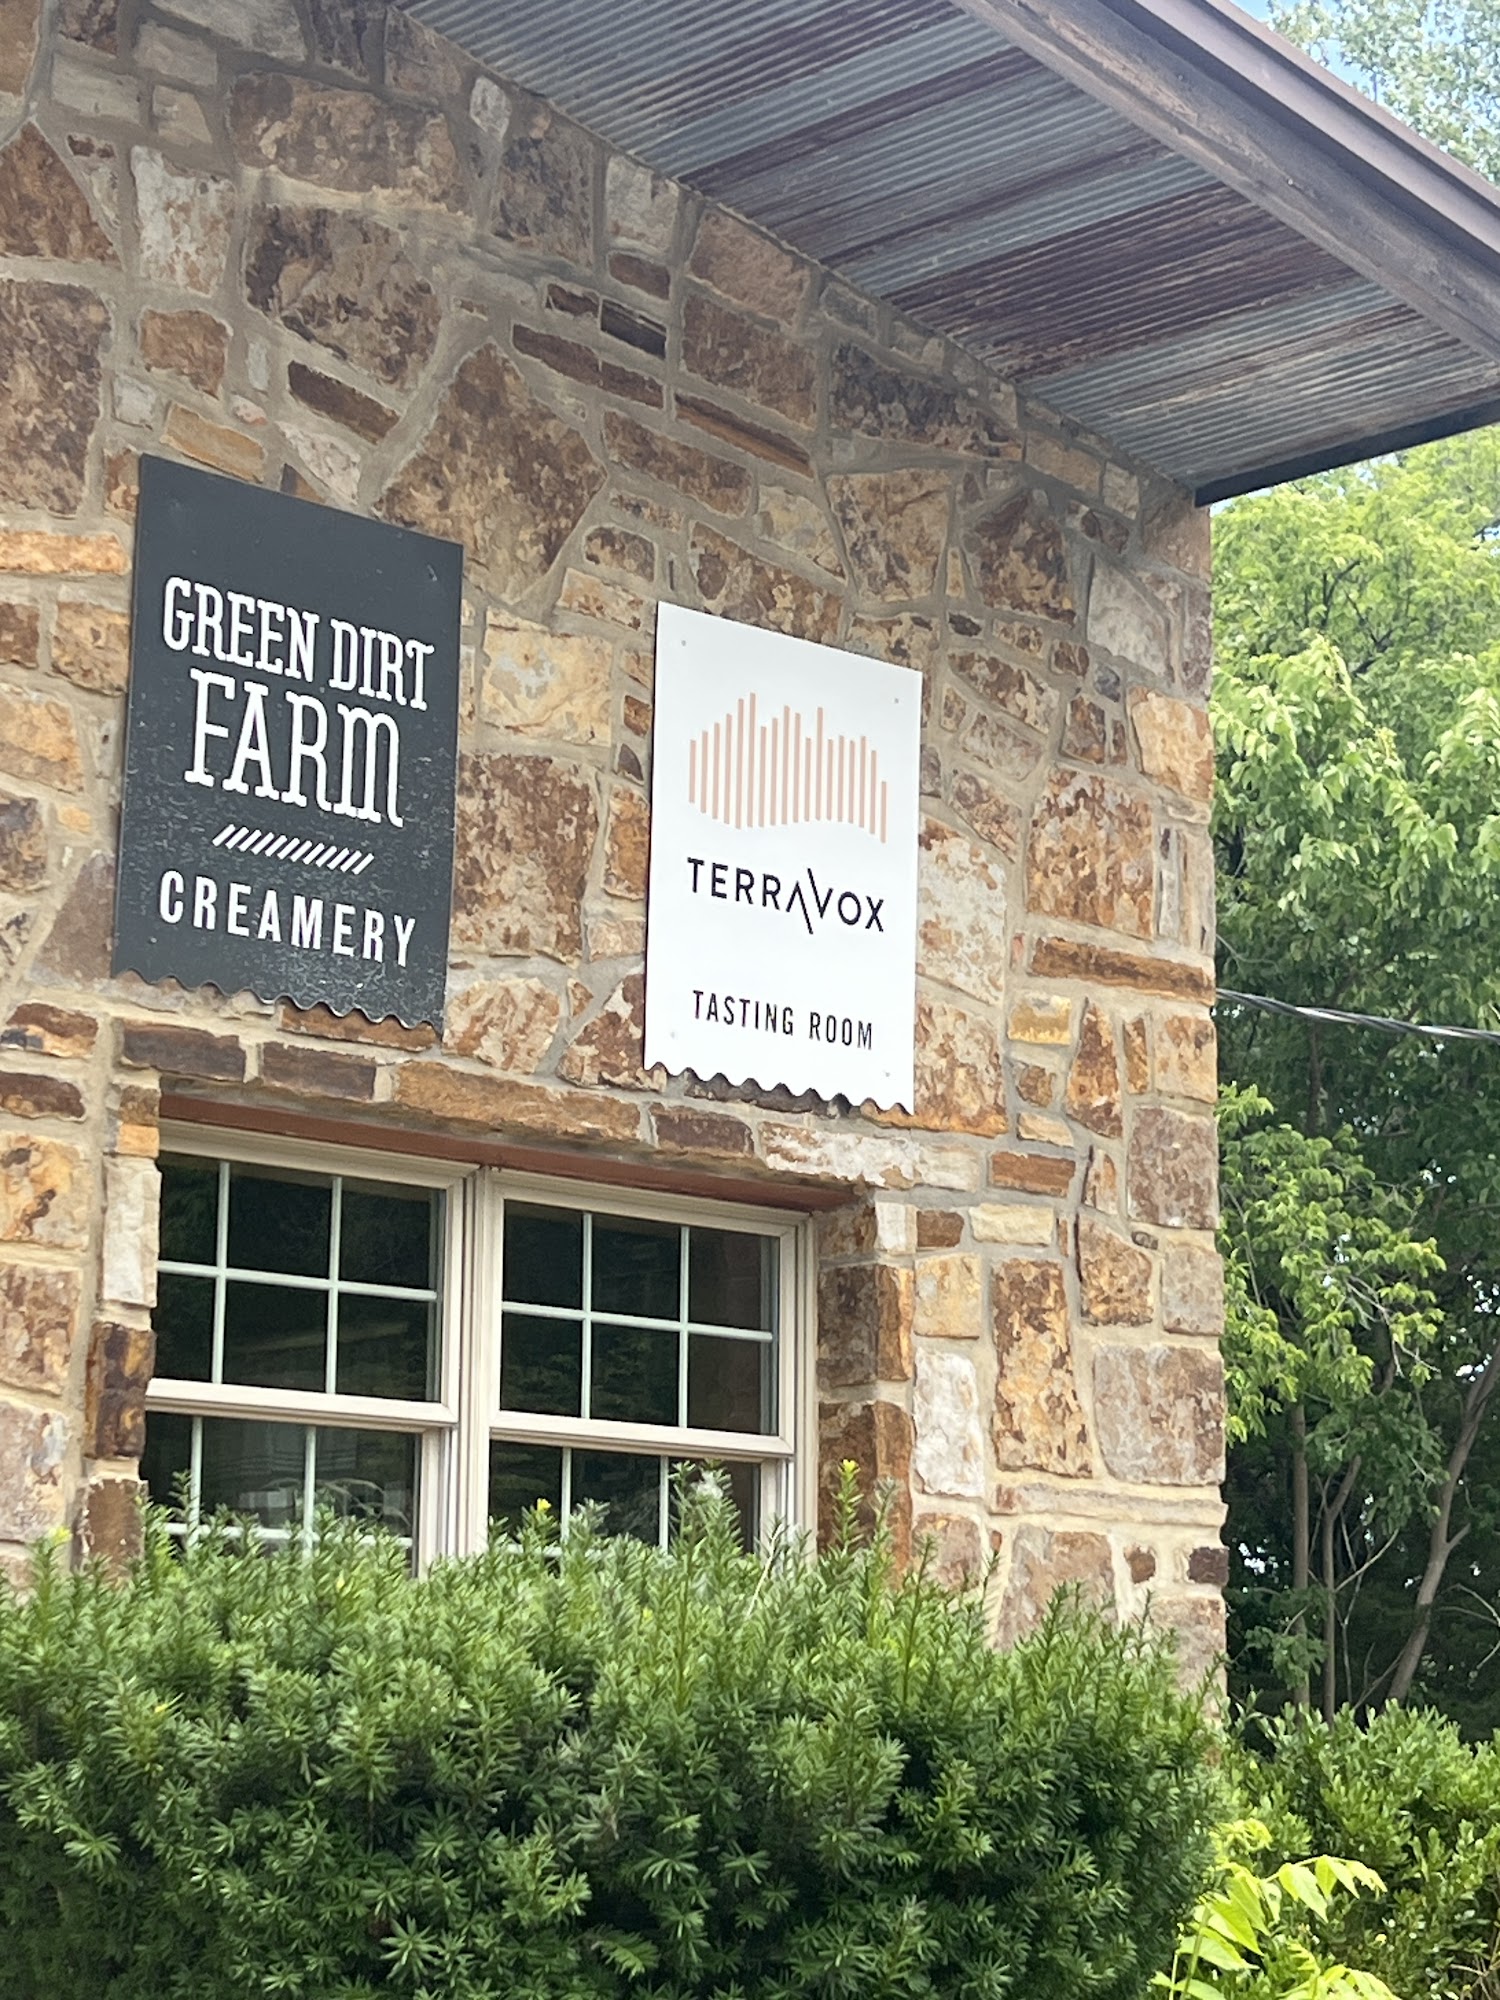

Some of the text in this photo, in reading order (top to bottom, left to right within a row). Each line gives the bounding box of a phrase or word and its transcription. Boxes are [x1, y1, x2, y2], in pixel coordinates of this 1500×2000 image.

[163, 576, 435, 711] GREEN DIRT
[184, 667, 404, 828] FARM
[159, 870, 416, 968] CREAMERY
[687, 856, 884, 935] TERRAVOX
[692, 989, 872, 1050] TASTING ROOM
